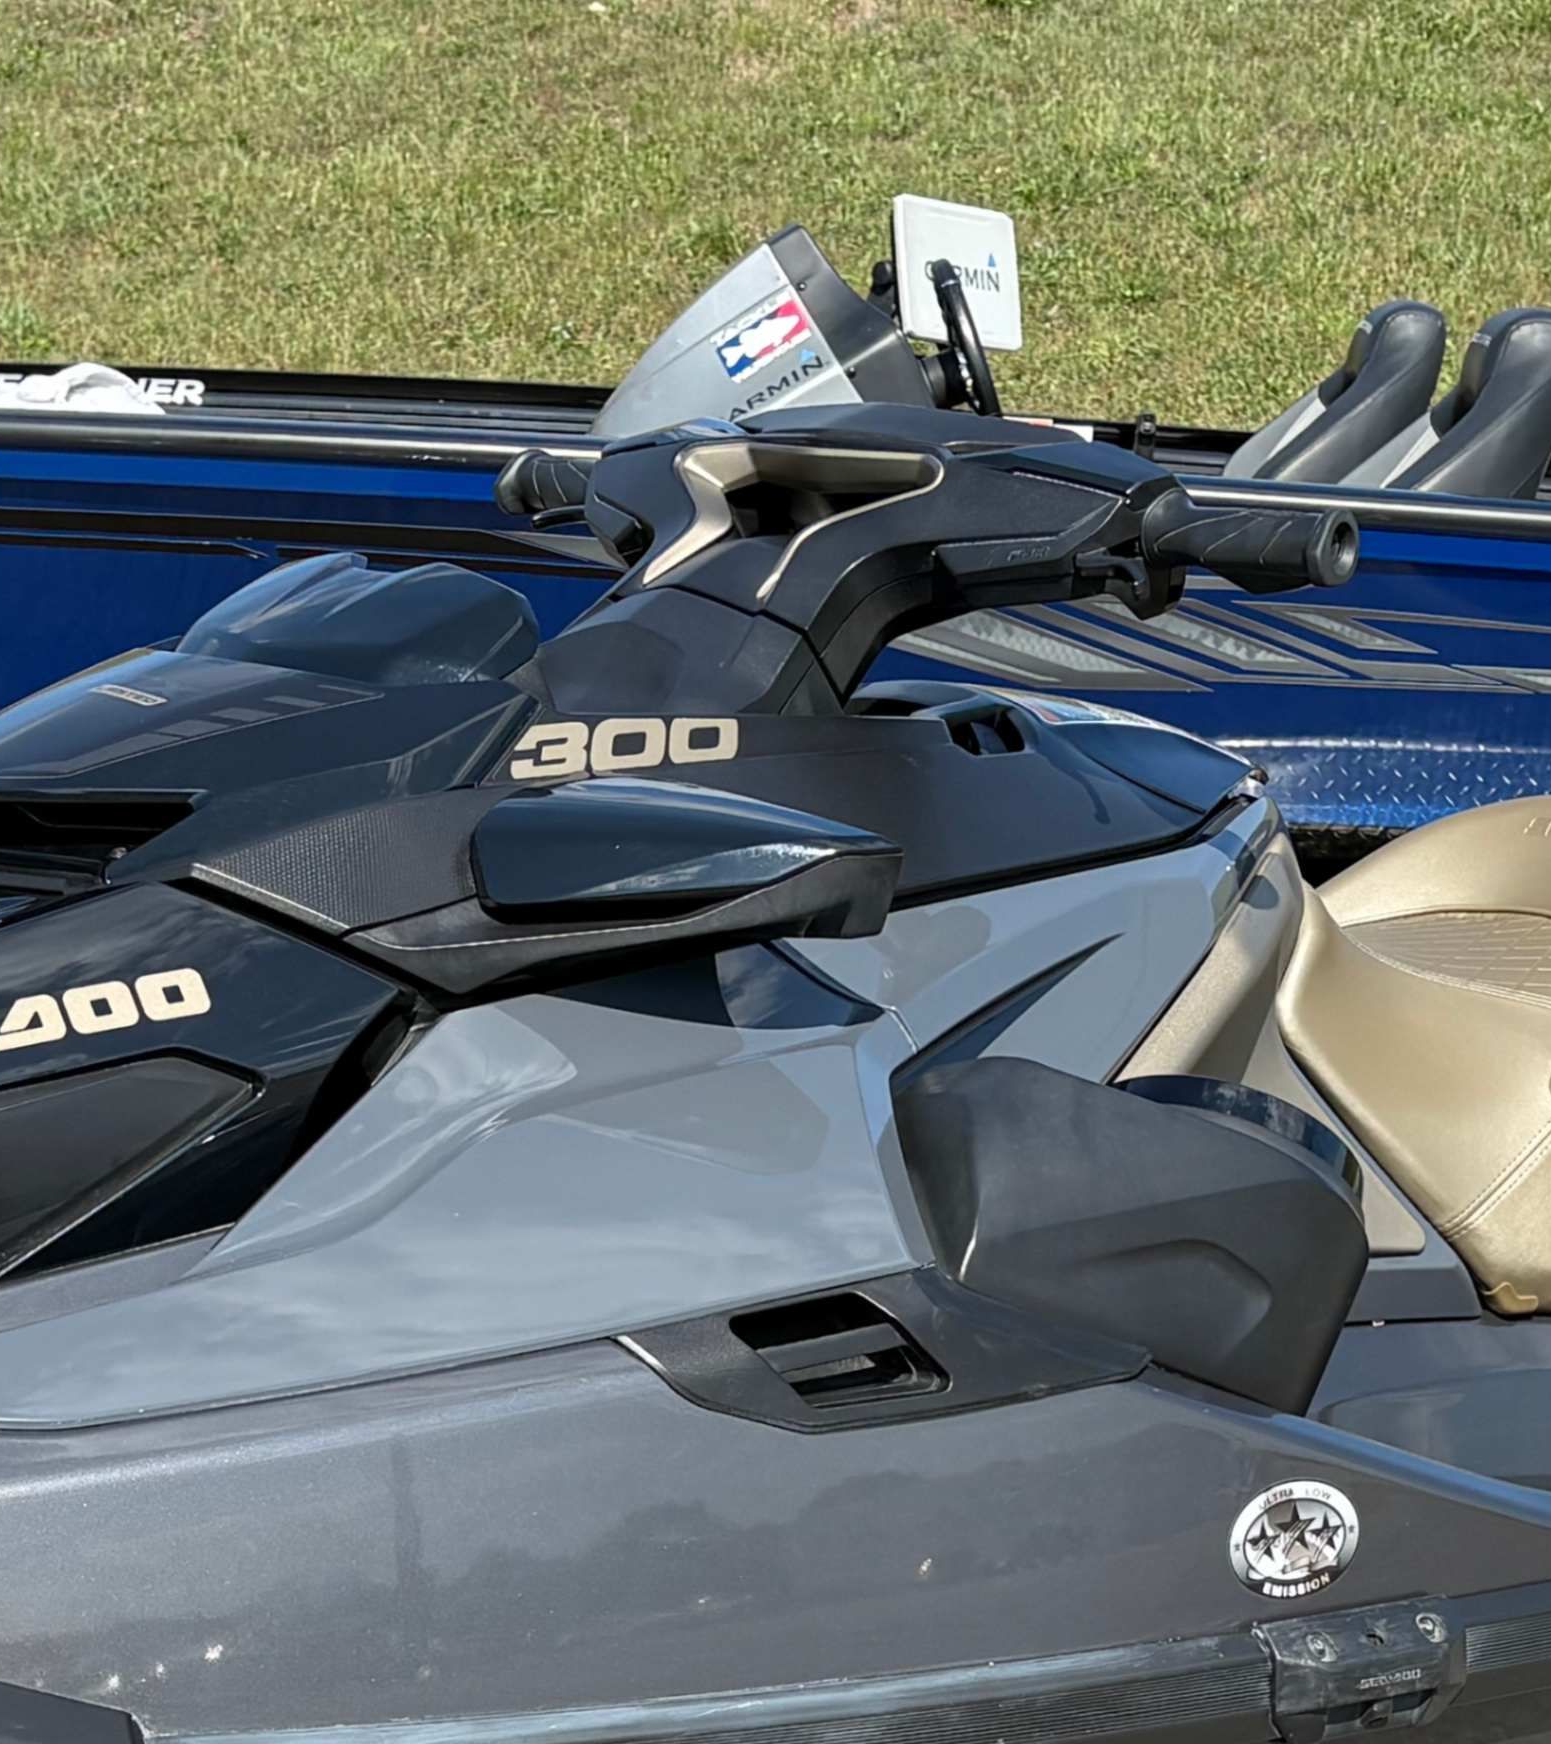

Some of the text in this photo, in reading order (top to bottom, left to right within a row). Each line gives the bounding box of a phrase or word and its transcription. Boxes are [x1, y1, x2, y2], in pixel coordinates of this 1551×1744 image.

[730, 355, 824, 422] ARMIN
[511, 718, 739, 780] 300
[1304, 1488, 1332, 1501] LOW
[1262, 1572, 1330, 1598] EMISSION
